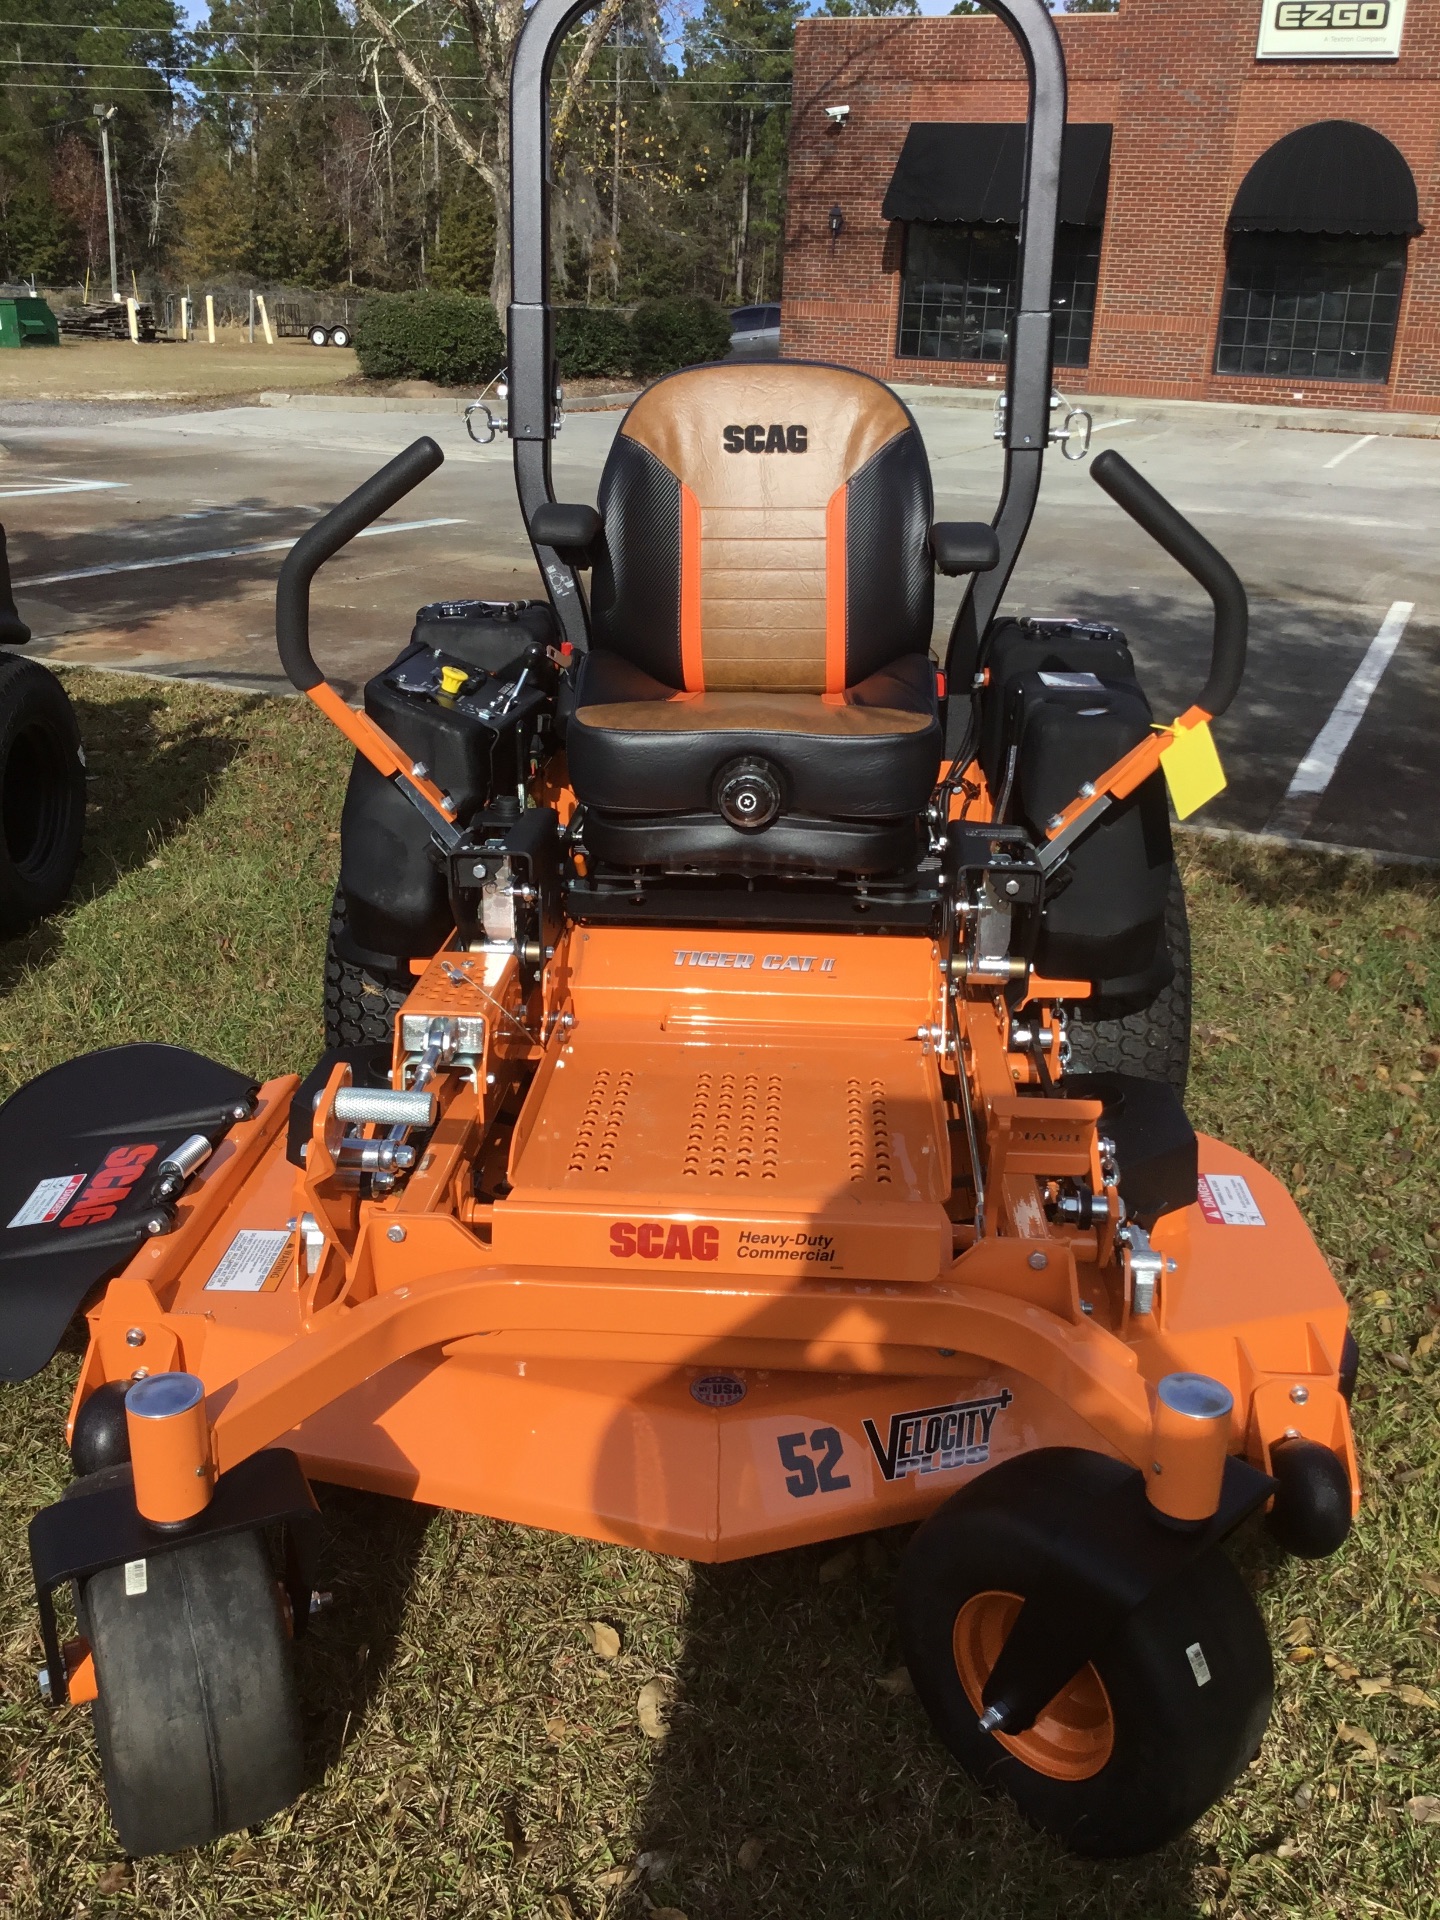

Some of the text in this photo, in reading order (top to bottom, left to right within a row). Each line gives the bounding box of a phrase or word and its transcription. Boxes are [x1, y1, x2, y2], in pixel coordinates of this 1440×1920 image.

[723, 425, 808, 454] SCAG
[673, 950, 837, 973] TIGER CAT II
[59, 1144, 159, 1229] SCAG
[48, 1188, 75, 1215] DANGER
[609, 1222, 719, 1261] SCAG
[738, 1230, 834, 1249] Heavy-Duty
[269, 1249, 294, 1279] WARNING
[736, 1246, 835, 1263] Commercial
[712, 1383, 742, 1394] USA
[777, 1426, 851, 1498] 52
[893, 1445, 990, 1480] PLUS
